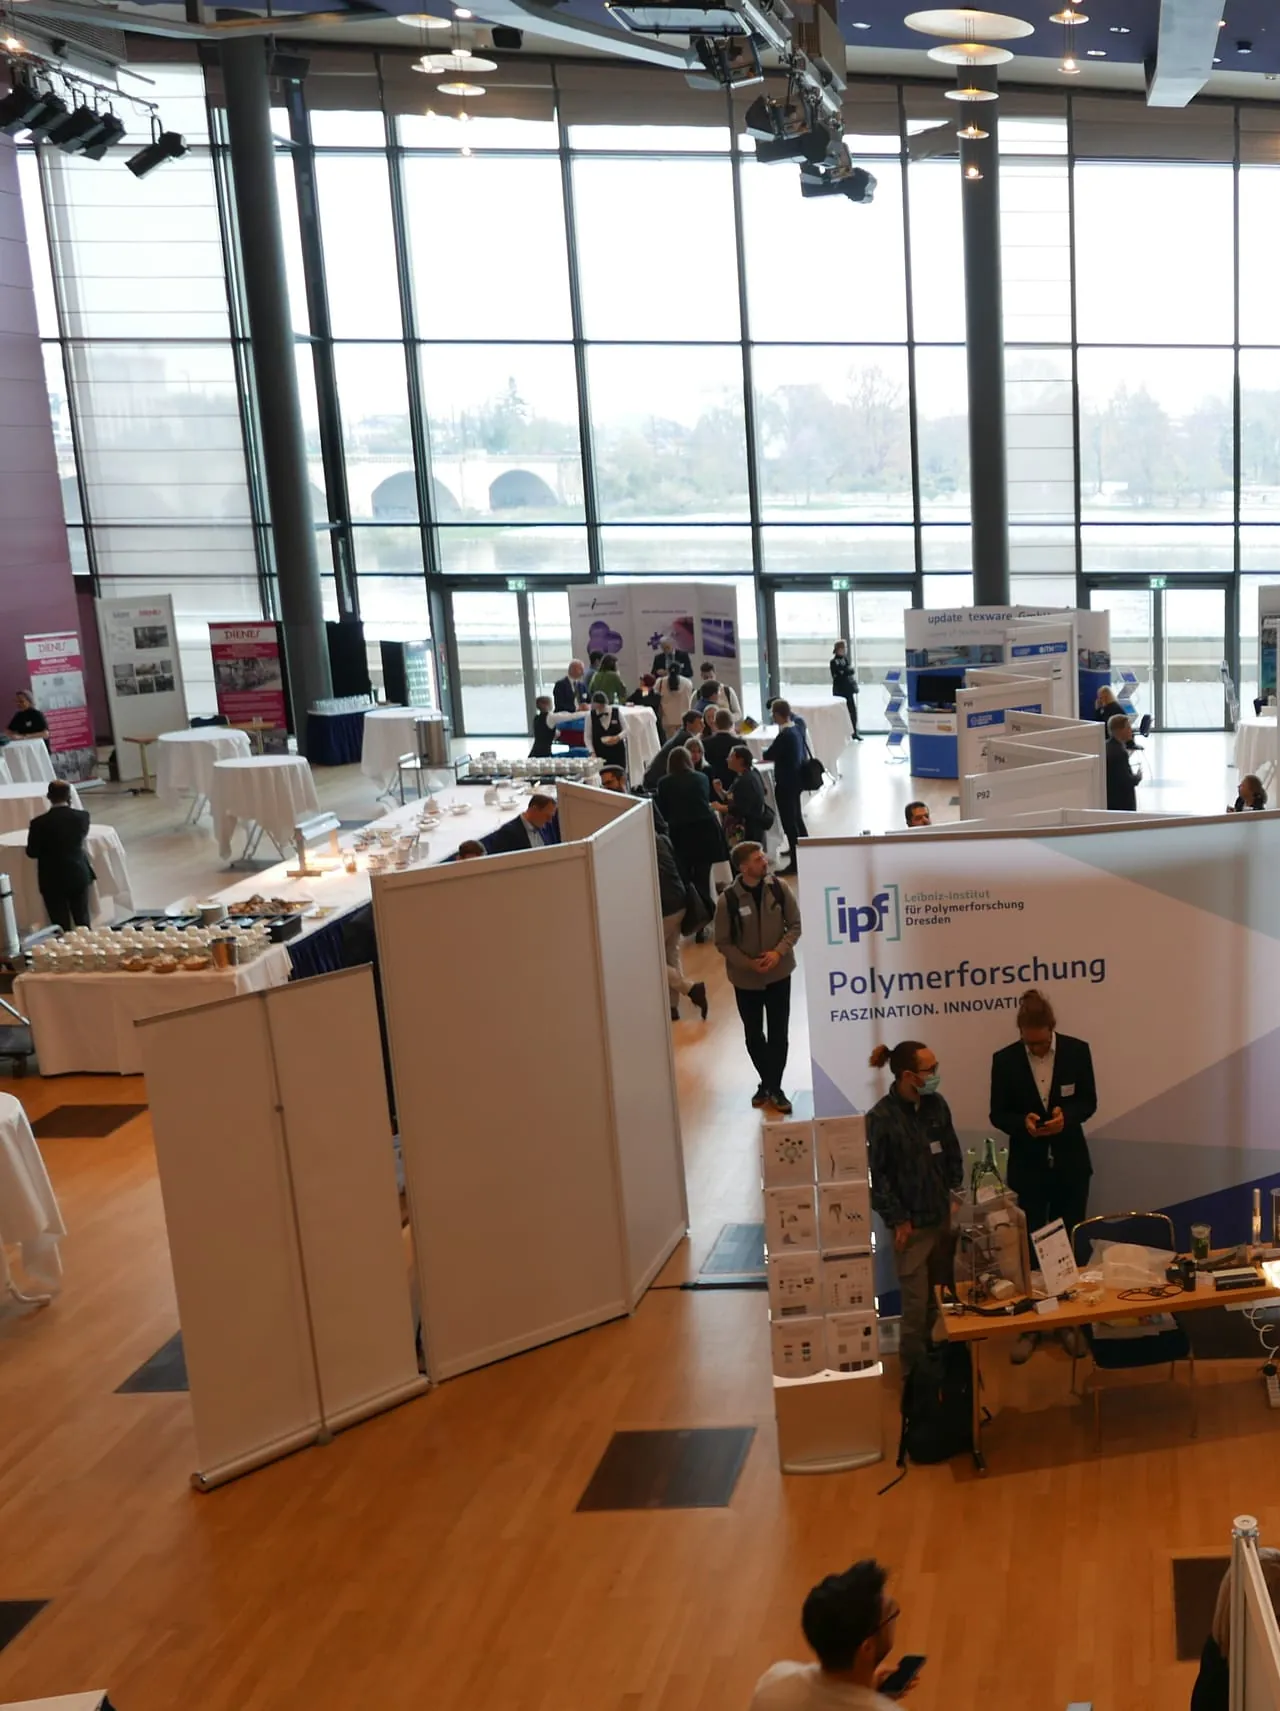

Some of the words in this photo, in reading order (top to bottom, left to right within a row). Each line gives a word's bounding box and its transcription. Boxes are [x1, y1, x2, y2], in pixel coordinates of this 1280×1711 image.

[928, 612, 962, 624] update
[968, 612, 1013, 622] texware
[976, 790, 990, 799] P92
[904, 890, 990, 903] Leibniz-Institut
[905, 903, 921, 915] für
[924, 899, 1025, 915] Polymerforschung
[905, 915, 951, 926] Dresden
[829, 956, 1106, 999] Polymerforschung
[830, 1002, 939, 1023] FASZINATION.
